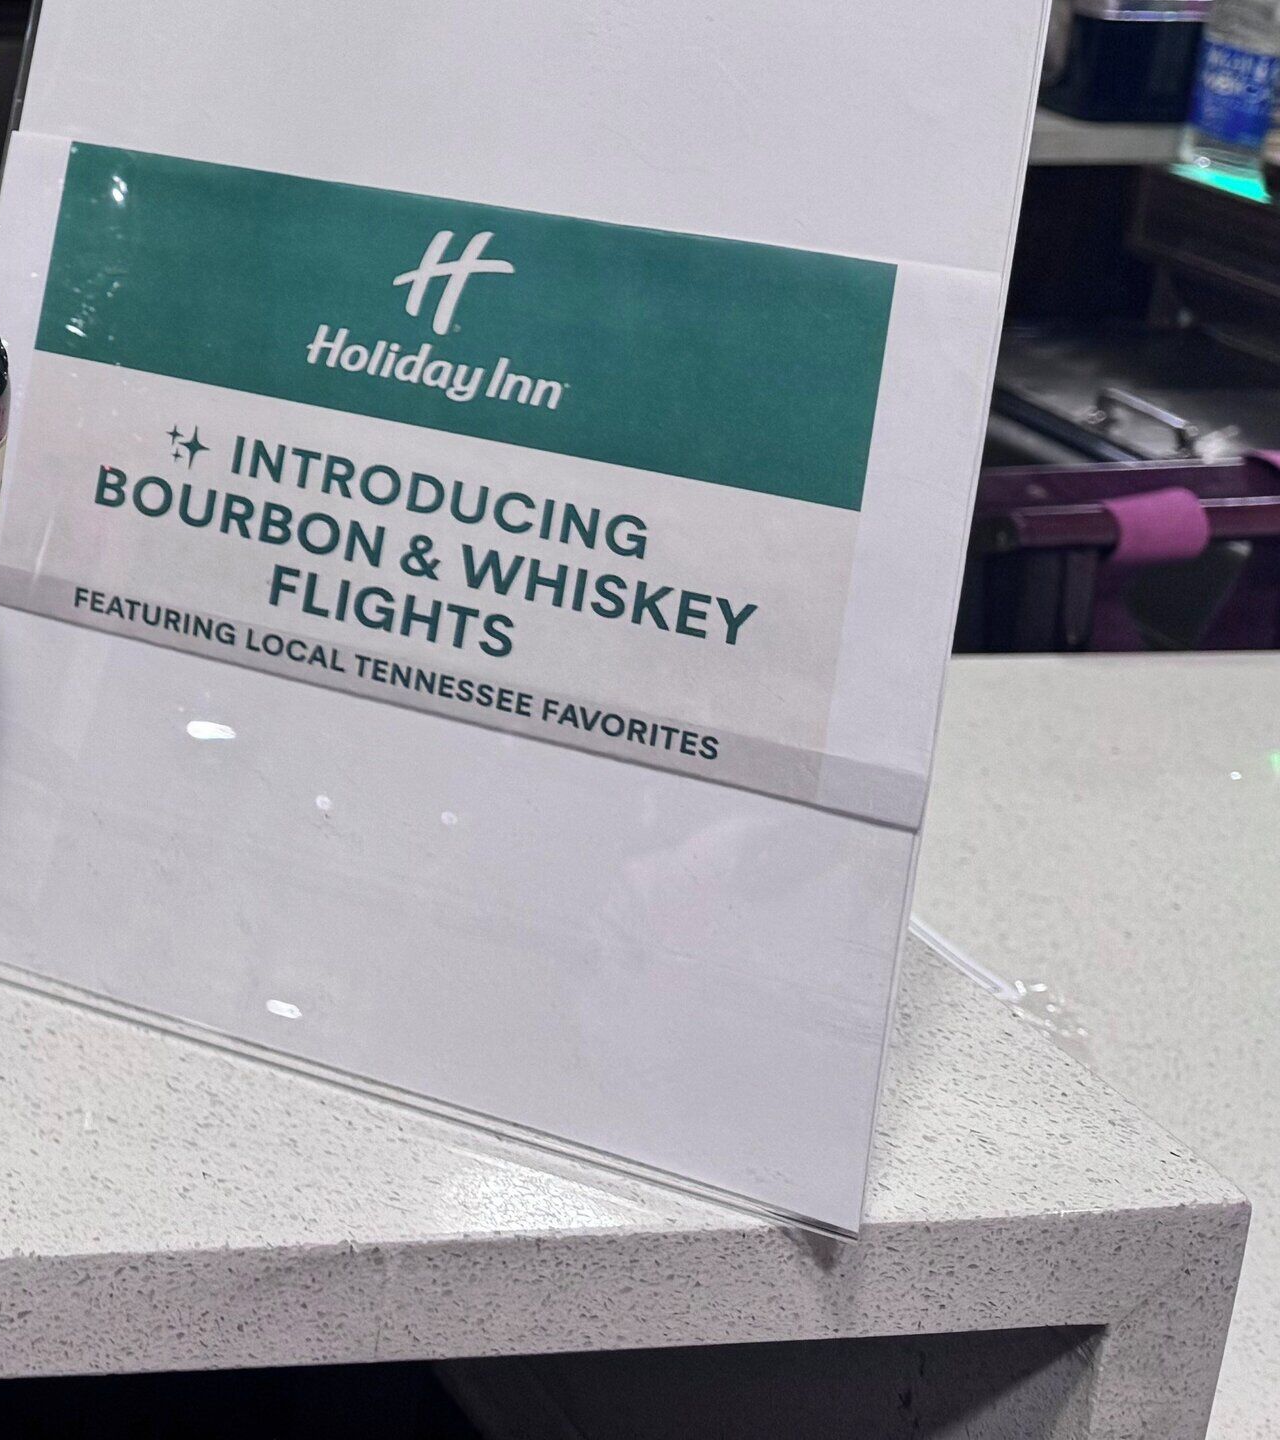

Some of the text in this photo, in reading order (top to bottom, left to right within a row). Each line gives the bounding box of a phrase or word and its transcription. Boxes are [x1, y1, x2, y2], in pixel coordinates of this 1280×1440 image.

[306, 323, 564, 412] Holiday Inn
[93, 465, 760, 647] BOURBON & WHISKEY
[231, 433, 650, 560] INTRODUCING
[73, 586, 721, 762] FEATURING LOCAL TENNESSEE FAVORITES
[267, 563, 516, 660] FLIGHTS
